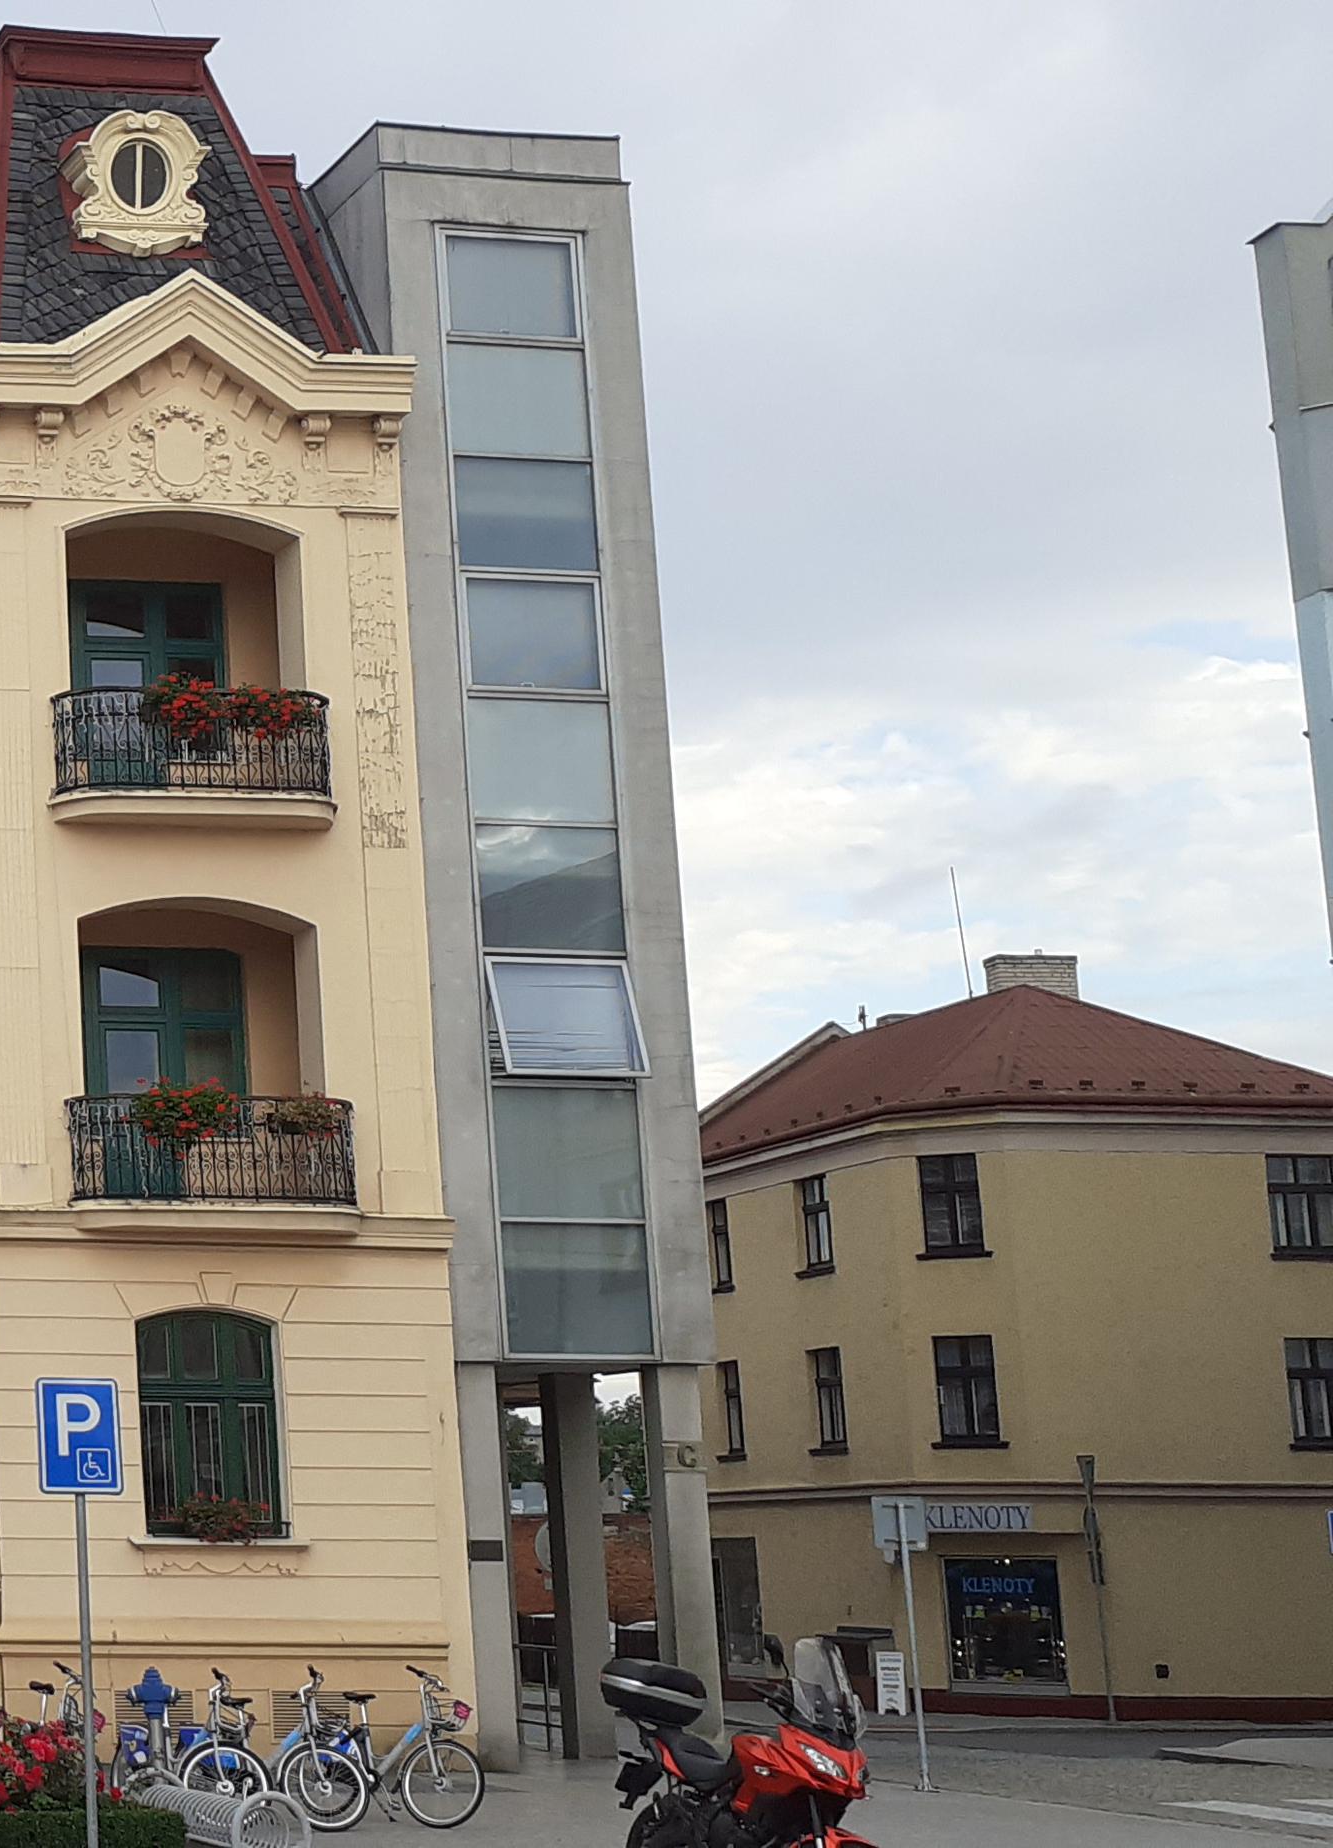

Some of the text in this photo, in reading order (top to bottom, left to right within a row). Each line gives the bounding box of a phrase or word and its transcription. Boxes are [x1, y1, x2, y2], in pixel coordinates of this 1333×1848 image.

[55, 1392, 101, 1457] P
[925, 1504, 1030, 1530] KLENOTY
[961, 1576, 1036, 1594] KLENOTY
